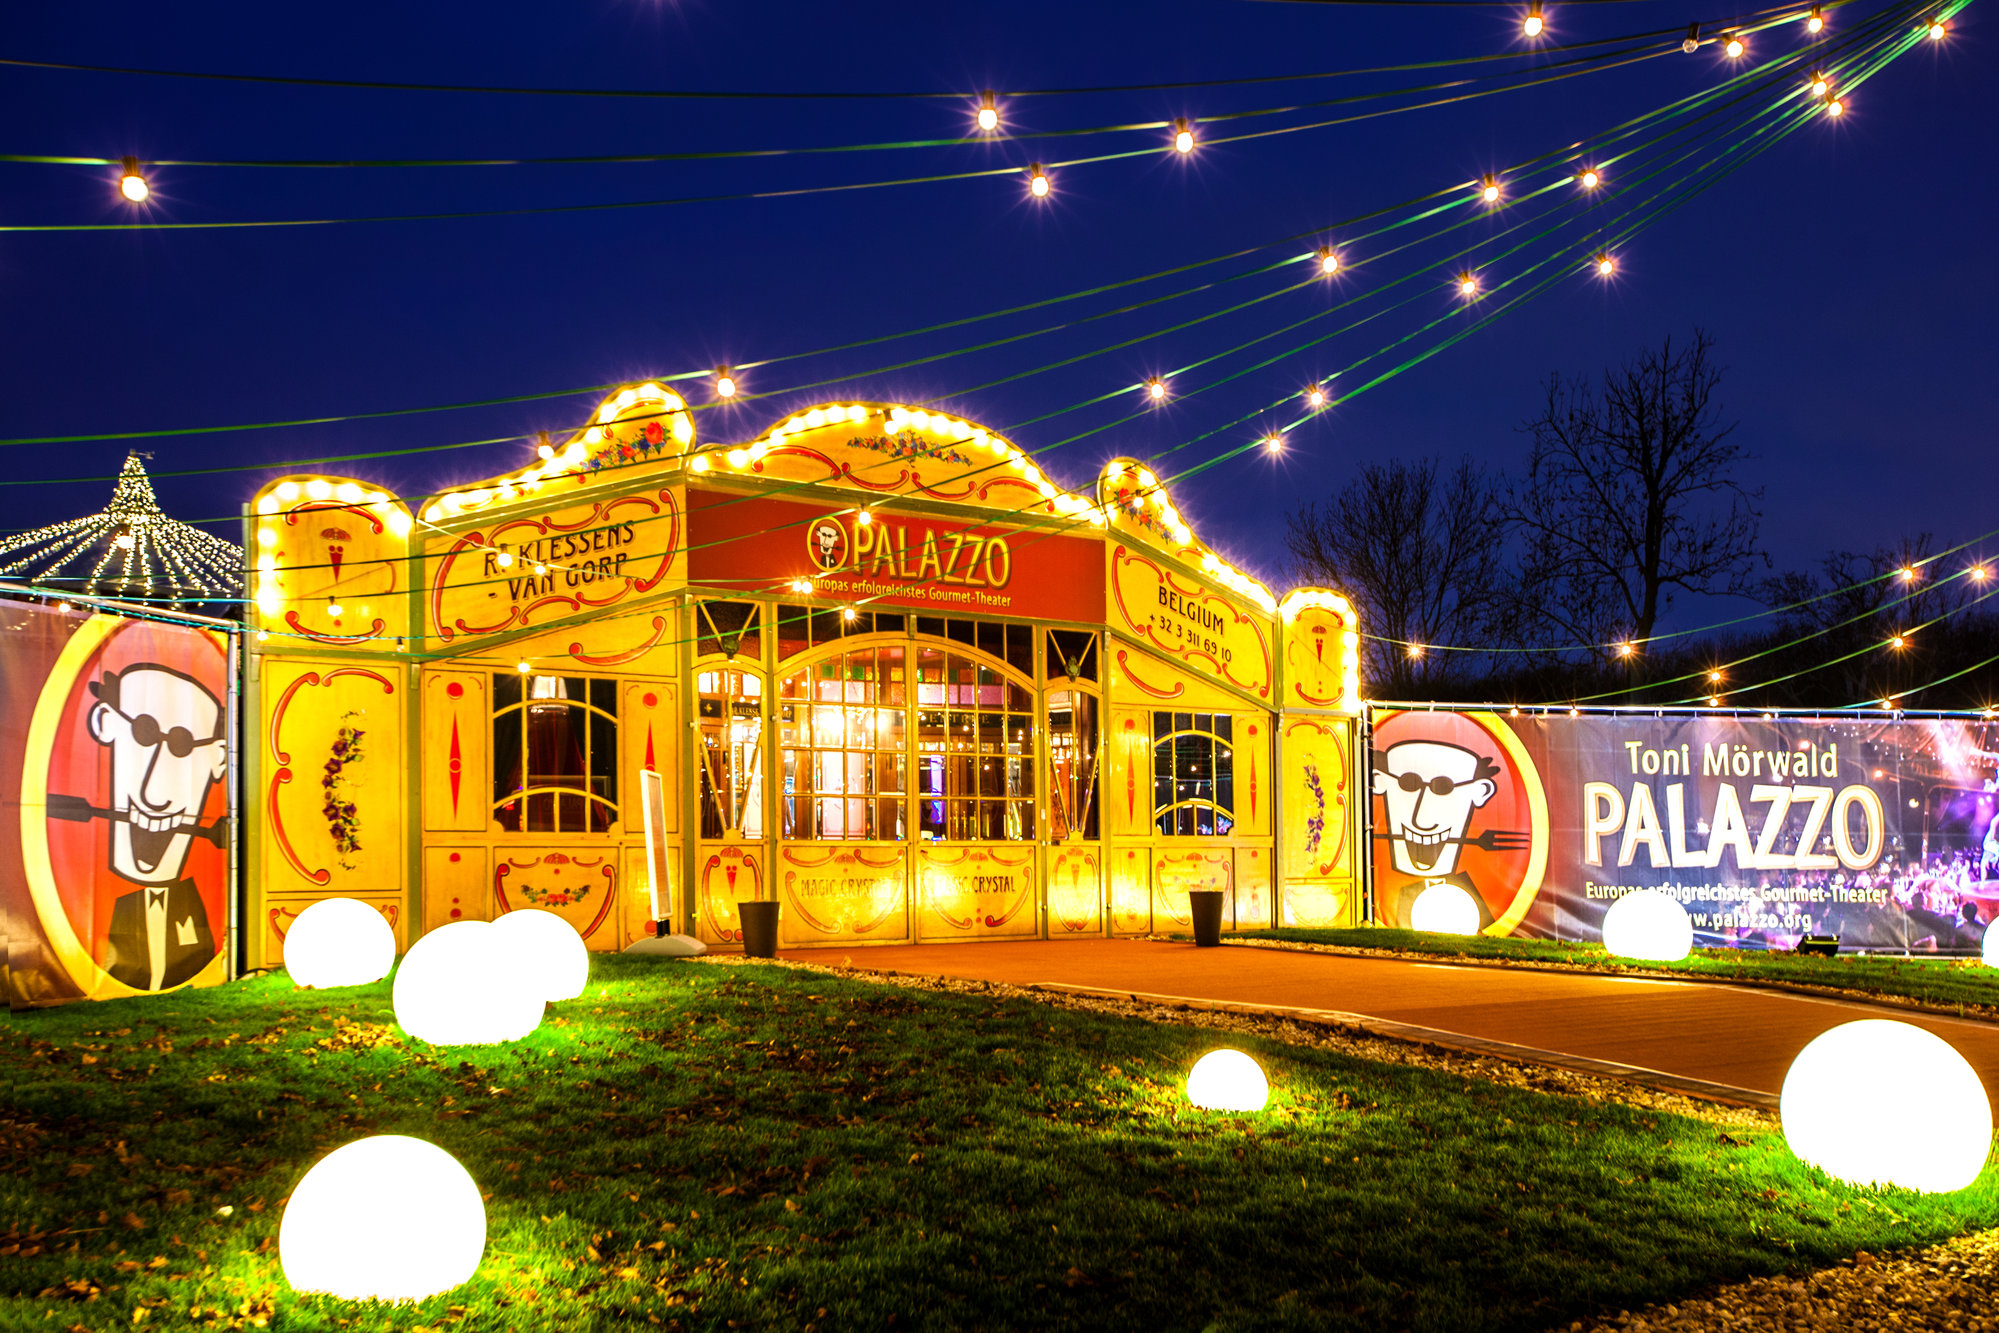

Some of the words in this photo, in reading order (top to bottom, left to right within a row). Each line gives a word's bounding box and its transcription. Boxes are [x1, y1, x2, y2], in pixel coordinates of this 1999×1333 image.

[484, 551, 506, 577] R.
[519, 520, 635, 570] KLESSENS
[852, 522, 1012, 589] PALAZZO
[508, 569, 555, 602] VAN
[566, 553, 627, 589] GORP
[809, 577, 849, 594] uropas
[852, 579, 926, 599] erfolgreichstes
[929, 586, 1012, 607] Gourmet-Theater
[1158, 585, 1224, 636] BELGIUM
[1159, 615, 1172, 633] 32
[1176, 624, 1183, 638] 3
[1187, 629, 1200, 647] 311
[1204, 638, 1217, 655] 69
[1222, 647, 1232, 662] 10
[1624, 740, 1690, 775] Toni
[1702, 742, 1839, 778] Mörwald
[1583, 781, 1886, 871] PALAZZO
[801, 879, 836, 897] MAGIC
[841, 878, 883, 896] CRYST
[971, 876, 1016, 893] CRYSTAL
[1760, 883, 1889, 905] Gourmet-Theater
[1686, 911, 1813, 932] w.palazzo.org
